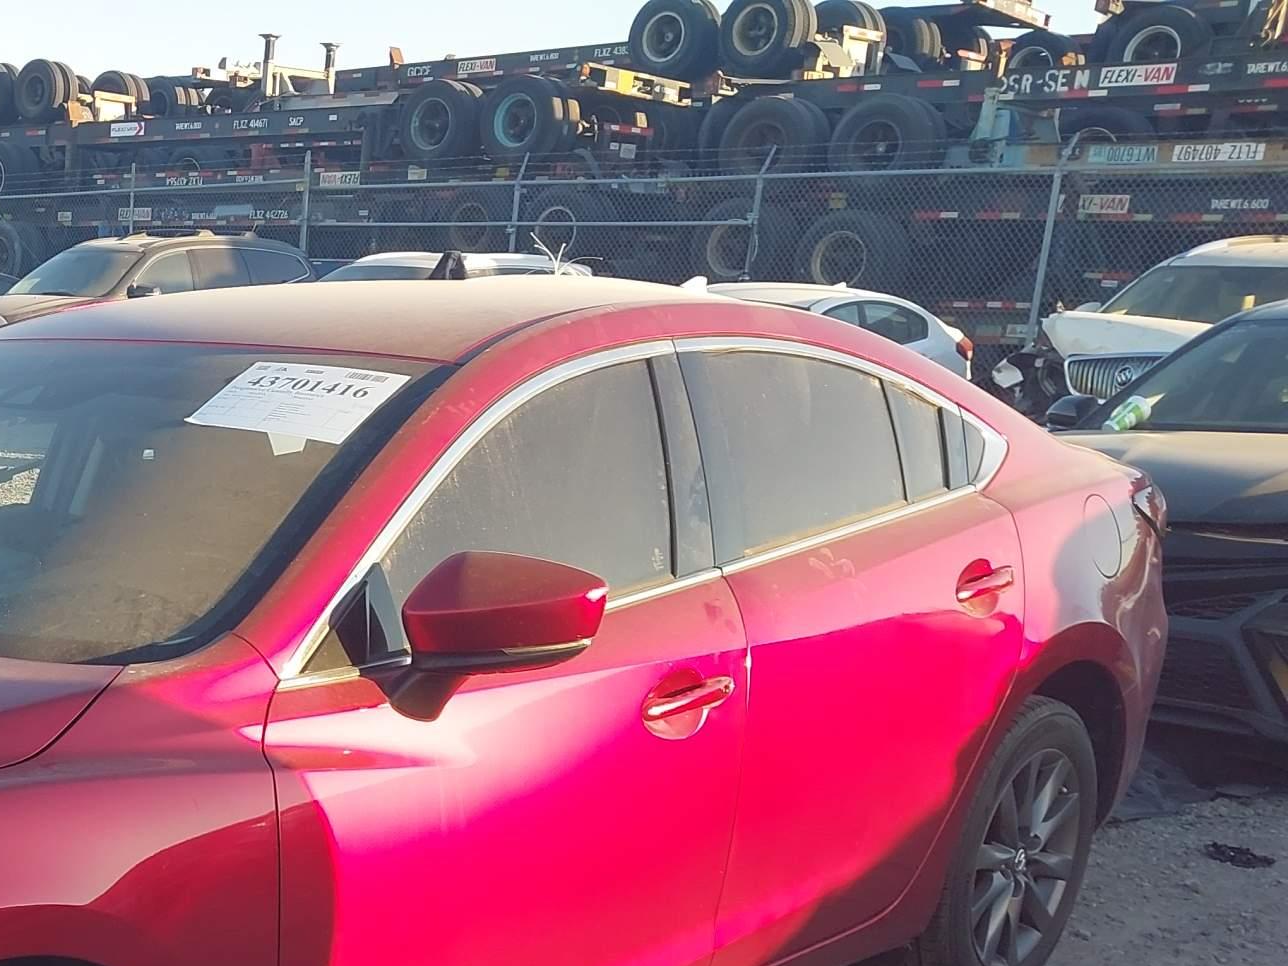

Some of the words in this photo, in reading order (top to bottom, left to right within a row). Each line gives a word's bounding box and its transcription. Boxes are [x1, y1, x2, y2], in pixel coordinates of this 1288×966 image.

[457, 60, 496, 73] FLEXI-VAN
[1100, 66, 1175, 84] FLEXI-VAN
[1176, 146, 1222, 161] 407497
[1229, 144, 1259, 160] FLTZ
[248, 374, 374, 399] 43701416
